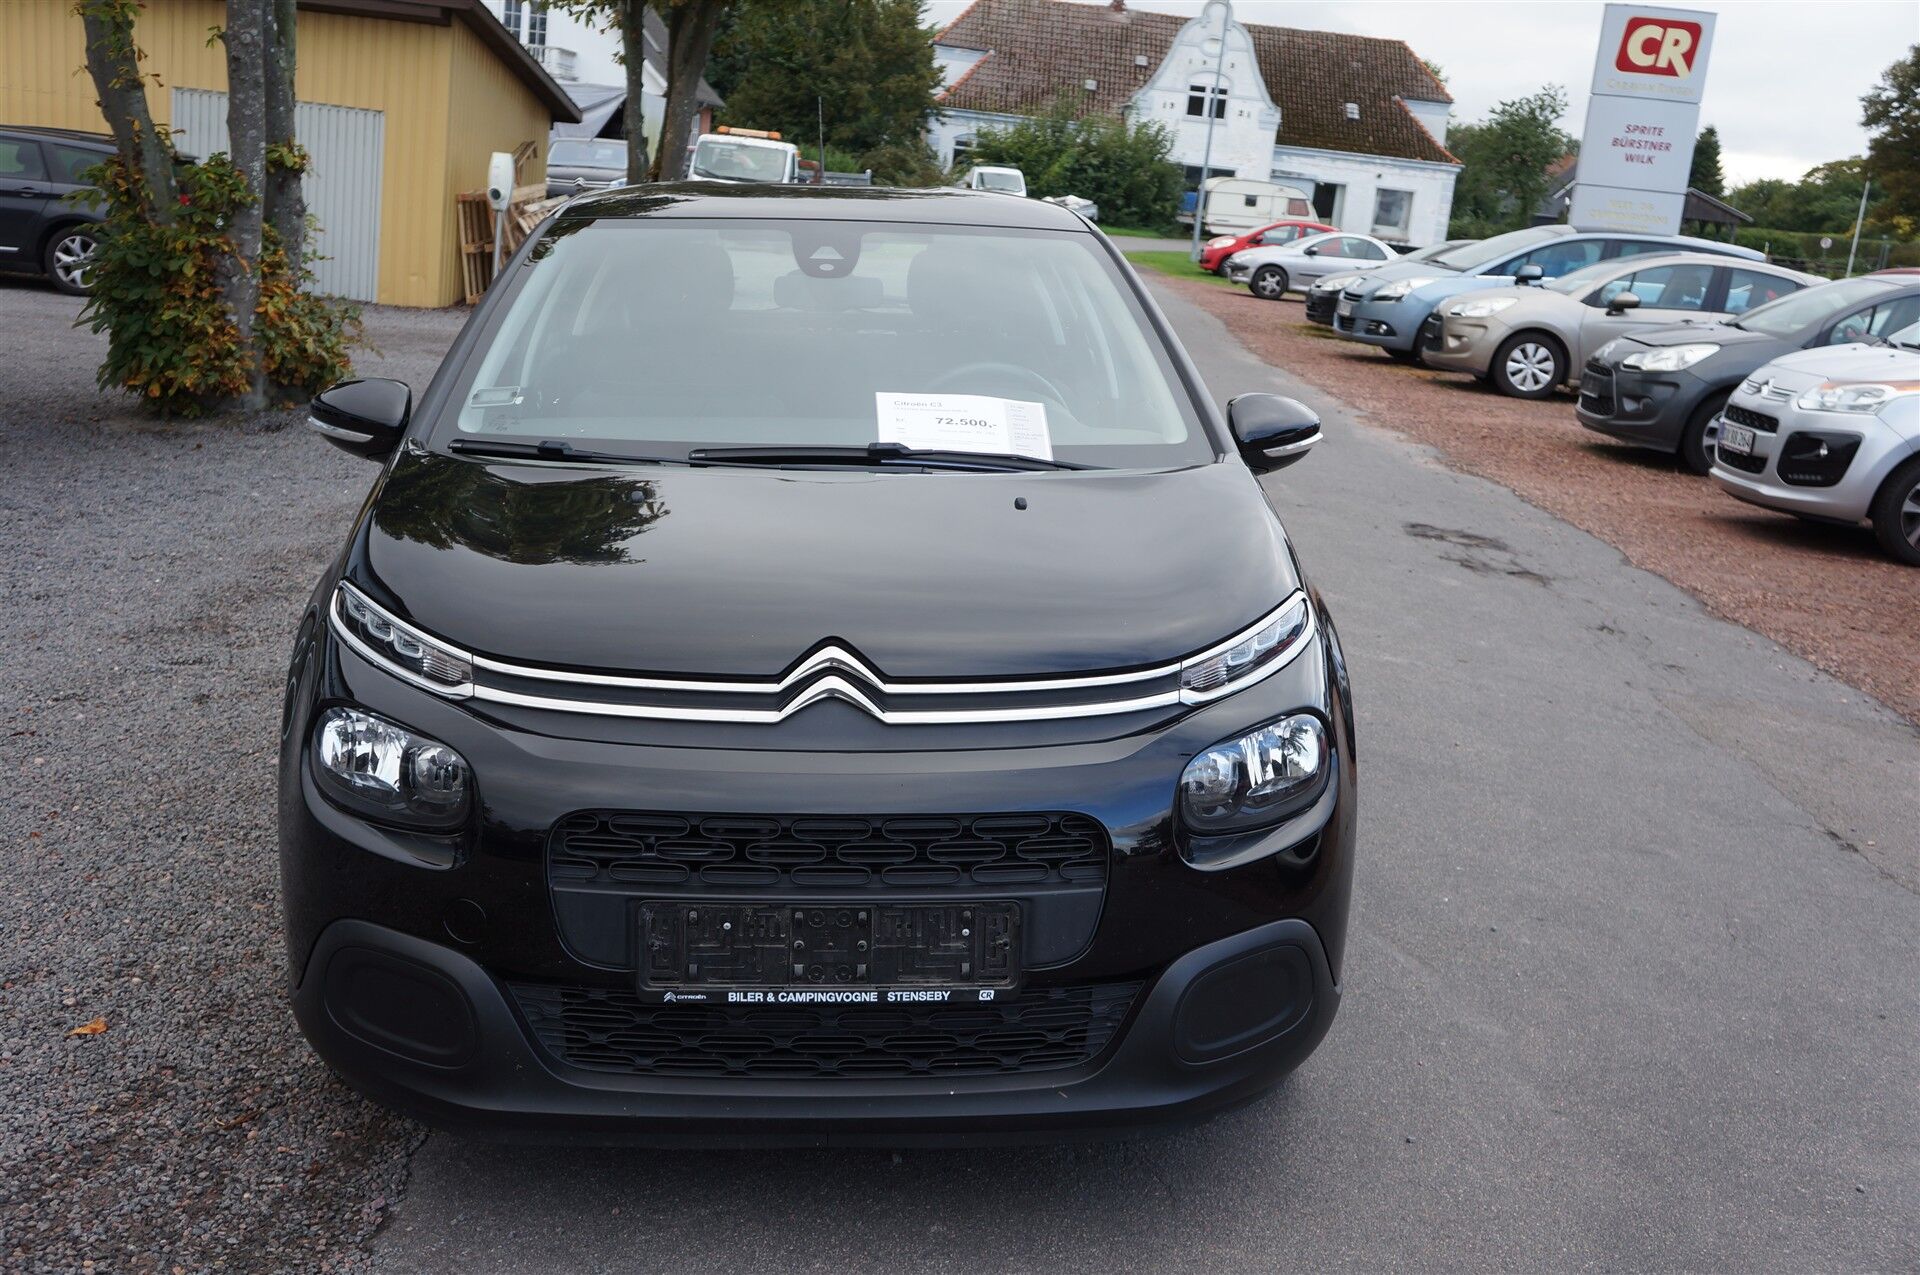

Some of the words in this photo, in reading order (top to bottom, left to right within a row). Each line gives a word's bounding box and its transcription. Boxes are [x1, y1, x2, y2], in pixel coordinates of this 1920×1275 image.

[1626, 24, 1692, 79] CR
[1624, 123, 1664, 137] SPRITE
[1624, 153, 1656, 165] WILK
[935, 417, 998, 429] 72.500,-
[728, 992, 764, 1002] BILER
[766, 992, 776, 1002] &
[778, 992, 878, 1002] CAMPINGVOGNE
[887, 991, 951, 1001] STENSEBY
[979, 990, 994, 1000] CR
